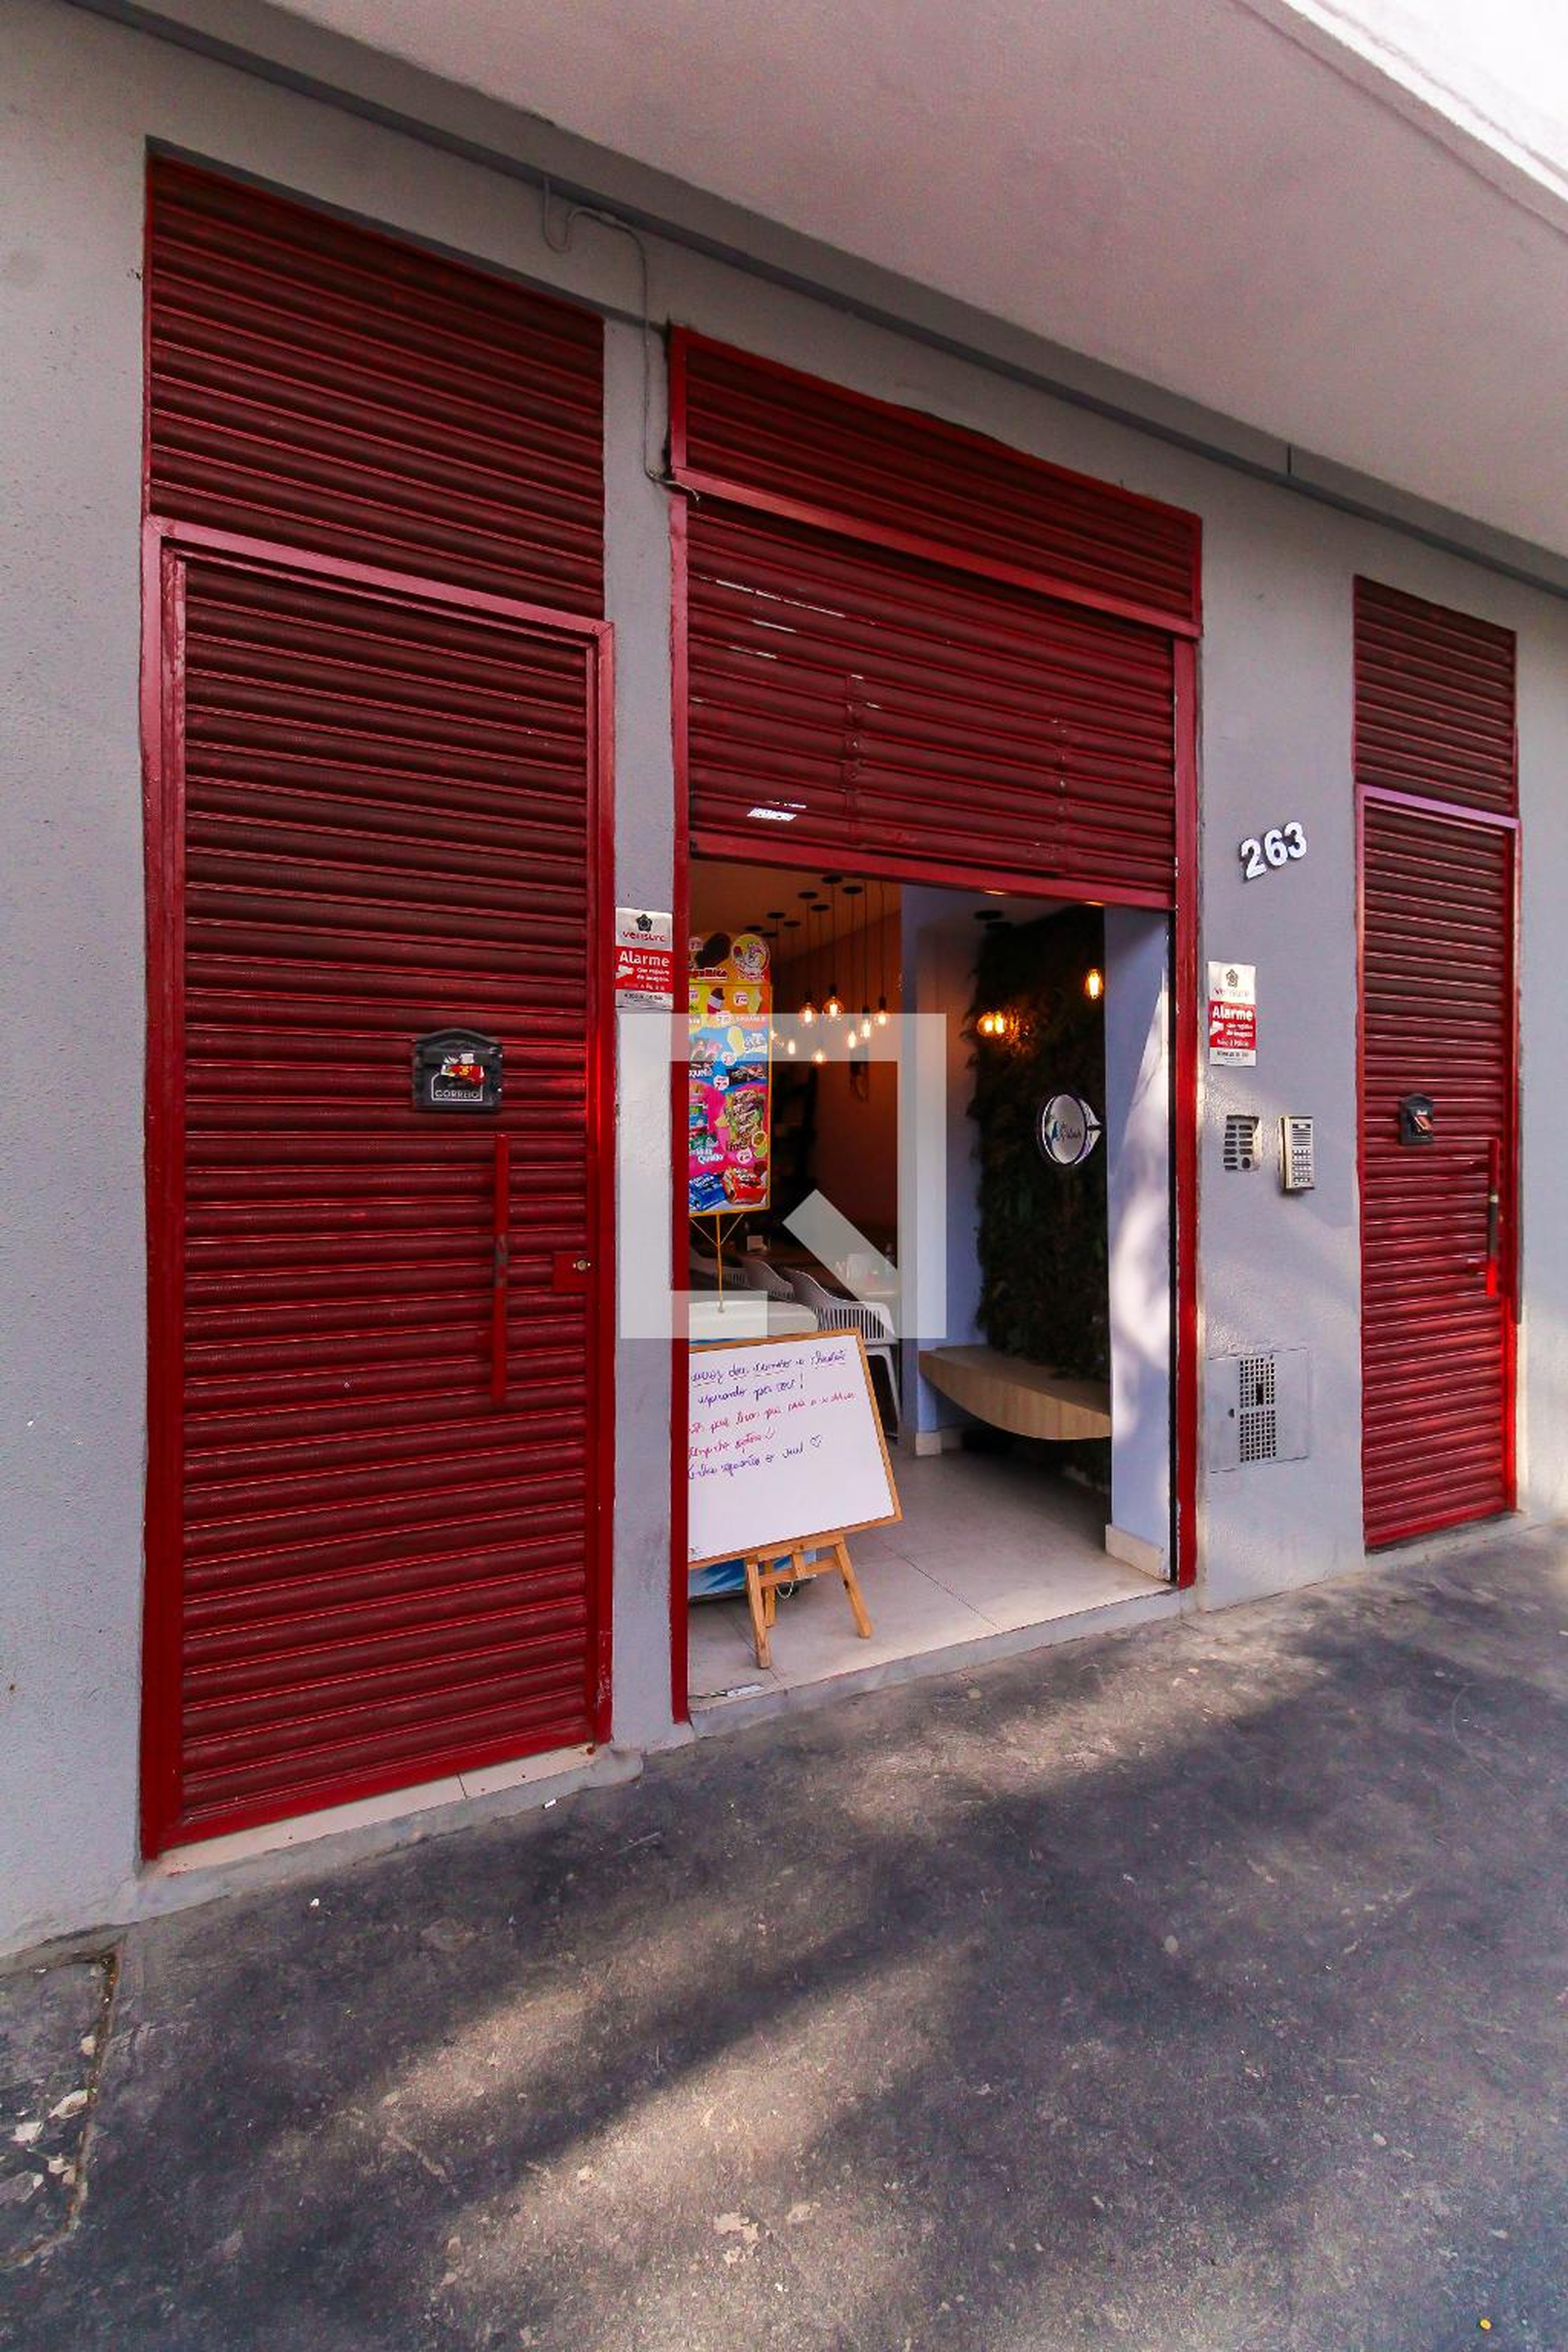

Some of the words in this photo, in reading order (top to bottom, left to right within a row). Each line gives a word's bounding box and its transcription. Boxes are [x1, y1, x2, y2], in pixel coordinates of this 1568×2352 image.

[1241, 821, 1307, 880] 263
[619, 951, 670, 967] Alarme
[1213, 1006, 1253, 1022] Alarme
[435, 1089, 479, 1098] CORREIO
